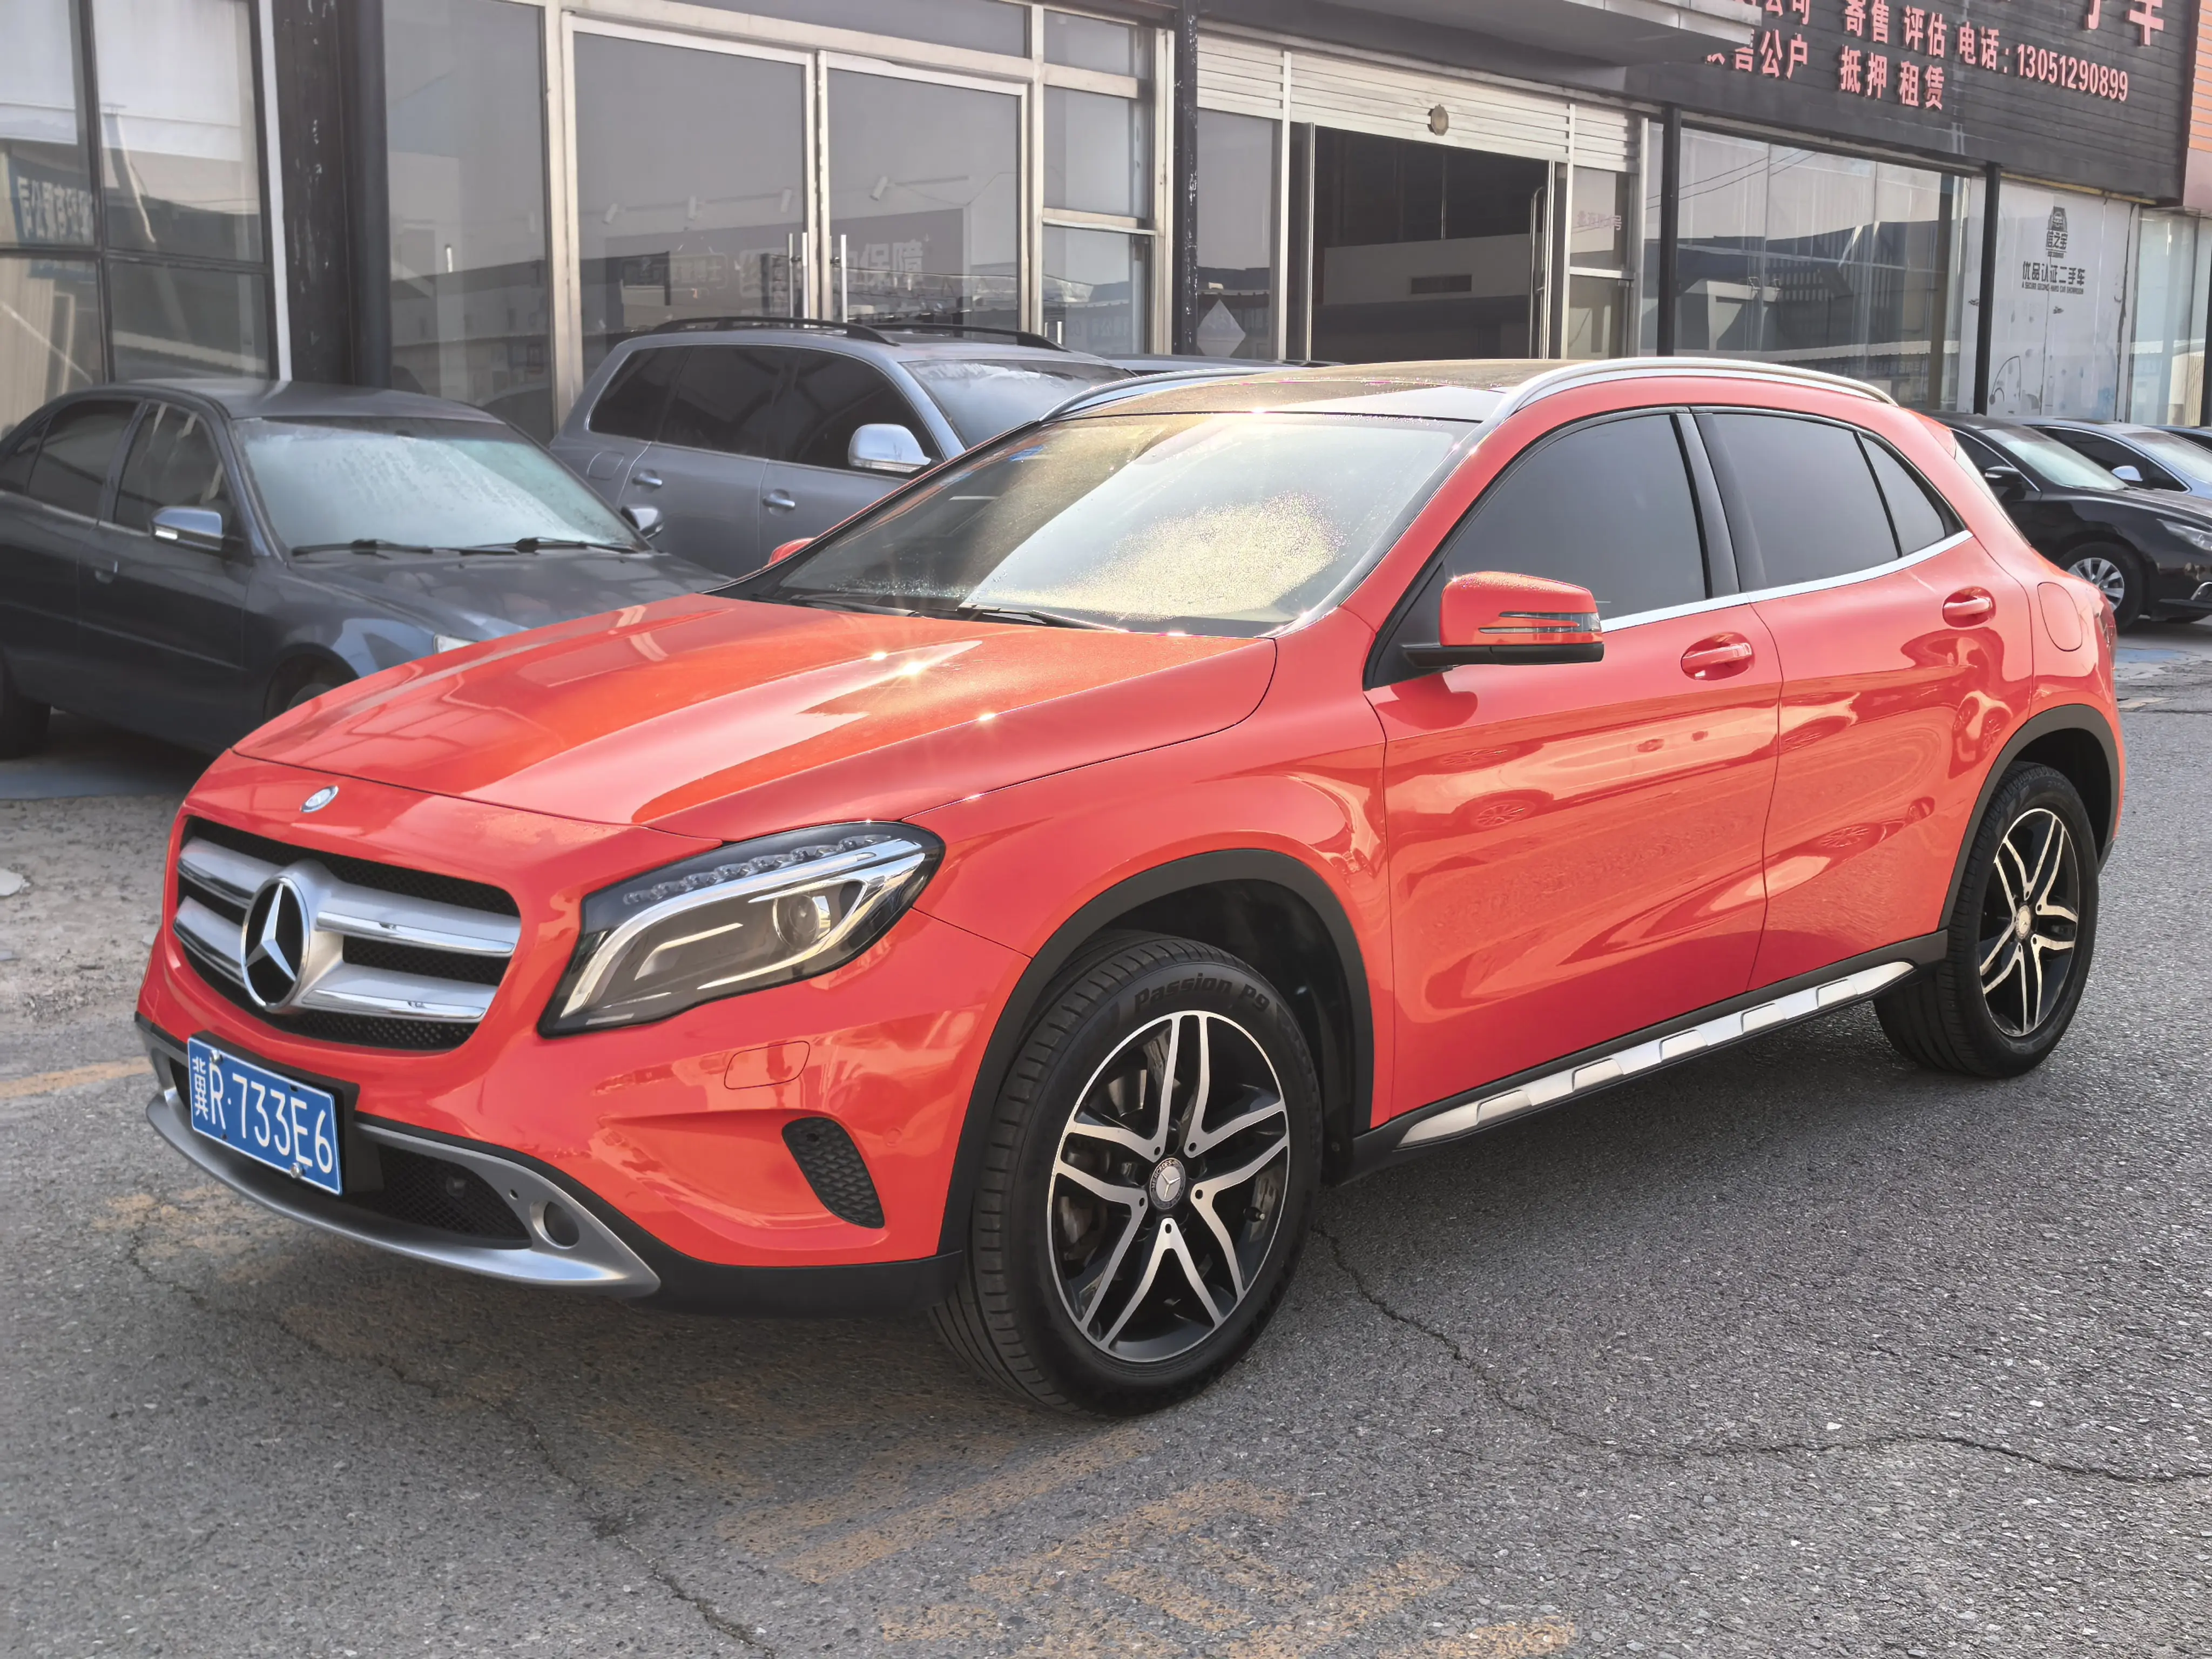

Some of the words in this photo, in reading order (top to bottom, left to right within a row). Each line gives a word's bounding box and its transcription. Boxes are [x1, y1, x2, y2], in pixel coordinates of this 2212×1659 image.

[1845, 0, 1889, 44] 寄售
[1903, 5, 1947, 58] 评估
[1840, 44, 1888, 99] 抵押
[1900, 60, 1944, 110] 租赁
[2022, 261, 2085, 286] 优品认证二手车
[1135, 973, 1232, 1012] Passion
[1239, 983, 1270, 1012] P9
